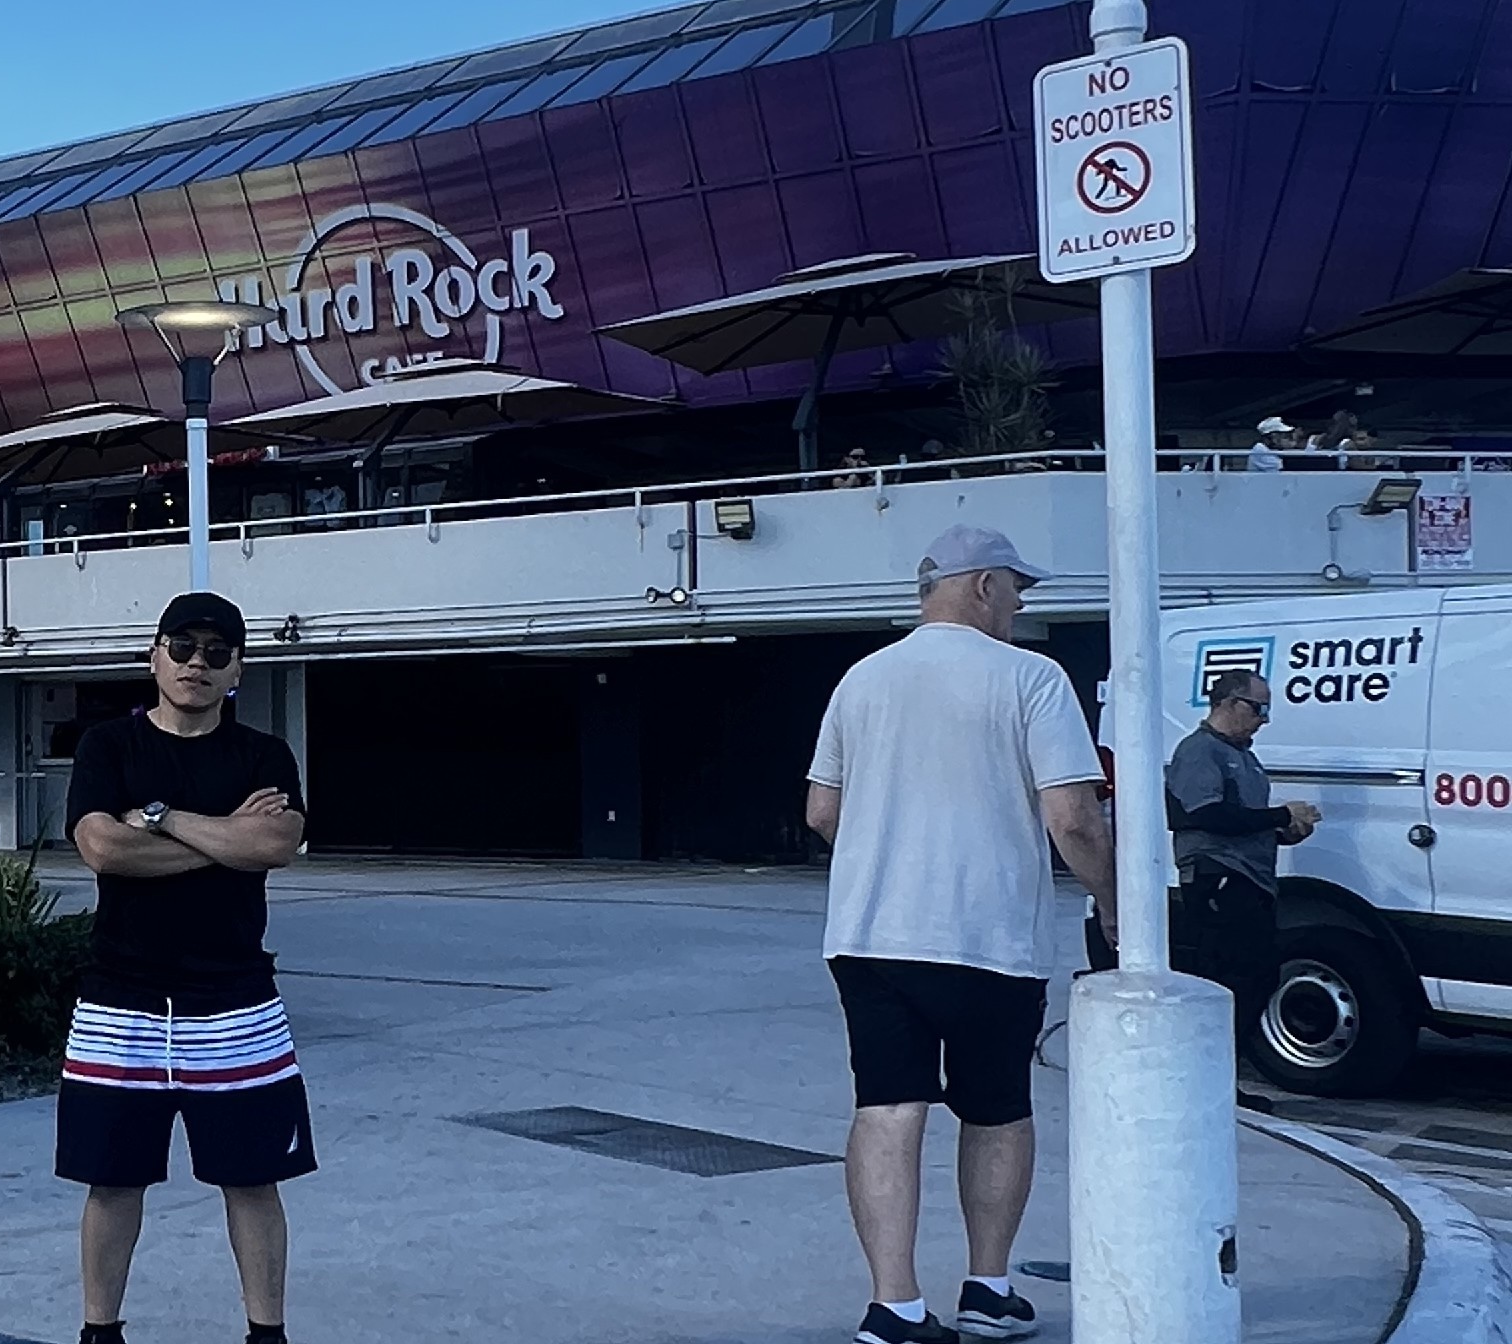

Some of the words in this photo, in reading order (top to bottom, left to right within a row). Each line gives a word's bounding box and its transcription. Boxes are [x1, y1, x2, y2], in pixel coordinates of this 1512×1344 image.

[1088, 67, 1130, 97] NO
[1051, 95, 1173, 143] SCOOTERS
[1058, 220, 1176, 257] ALLOWED
[388, 228, 564, 338] Rock
[1288, 627, 1424, 670] smart
[1285, 672, 1390, 704] care
[1434, 772, 1510, 808] 800
